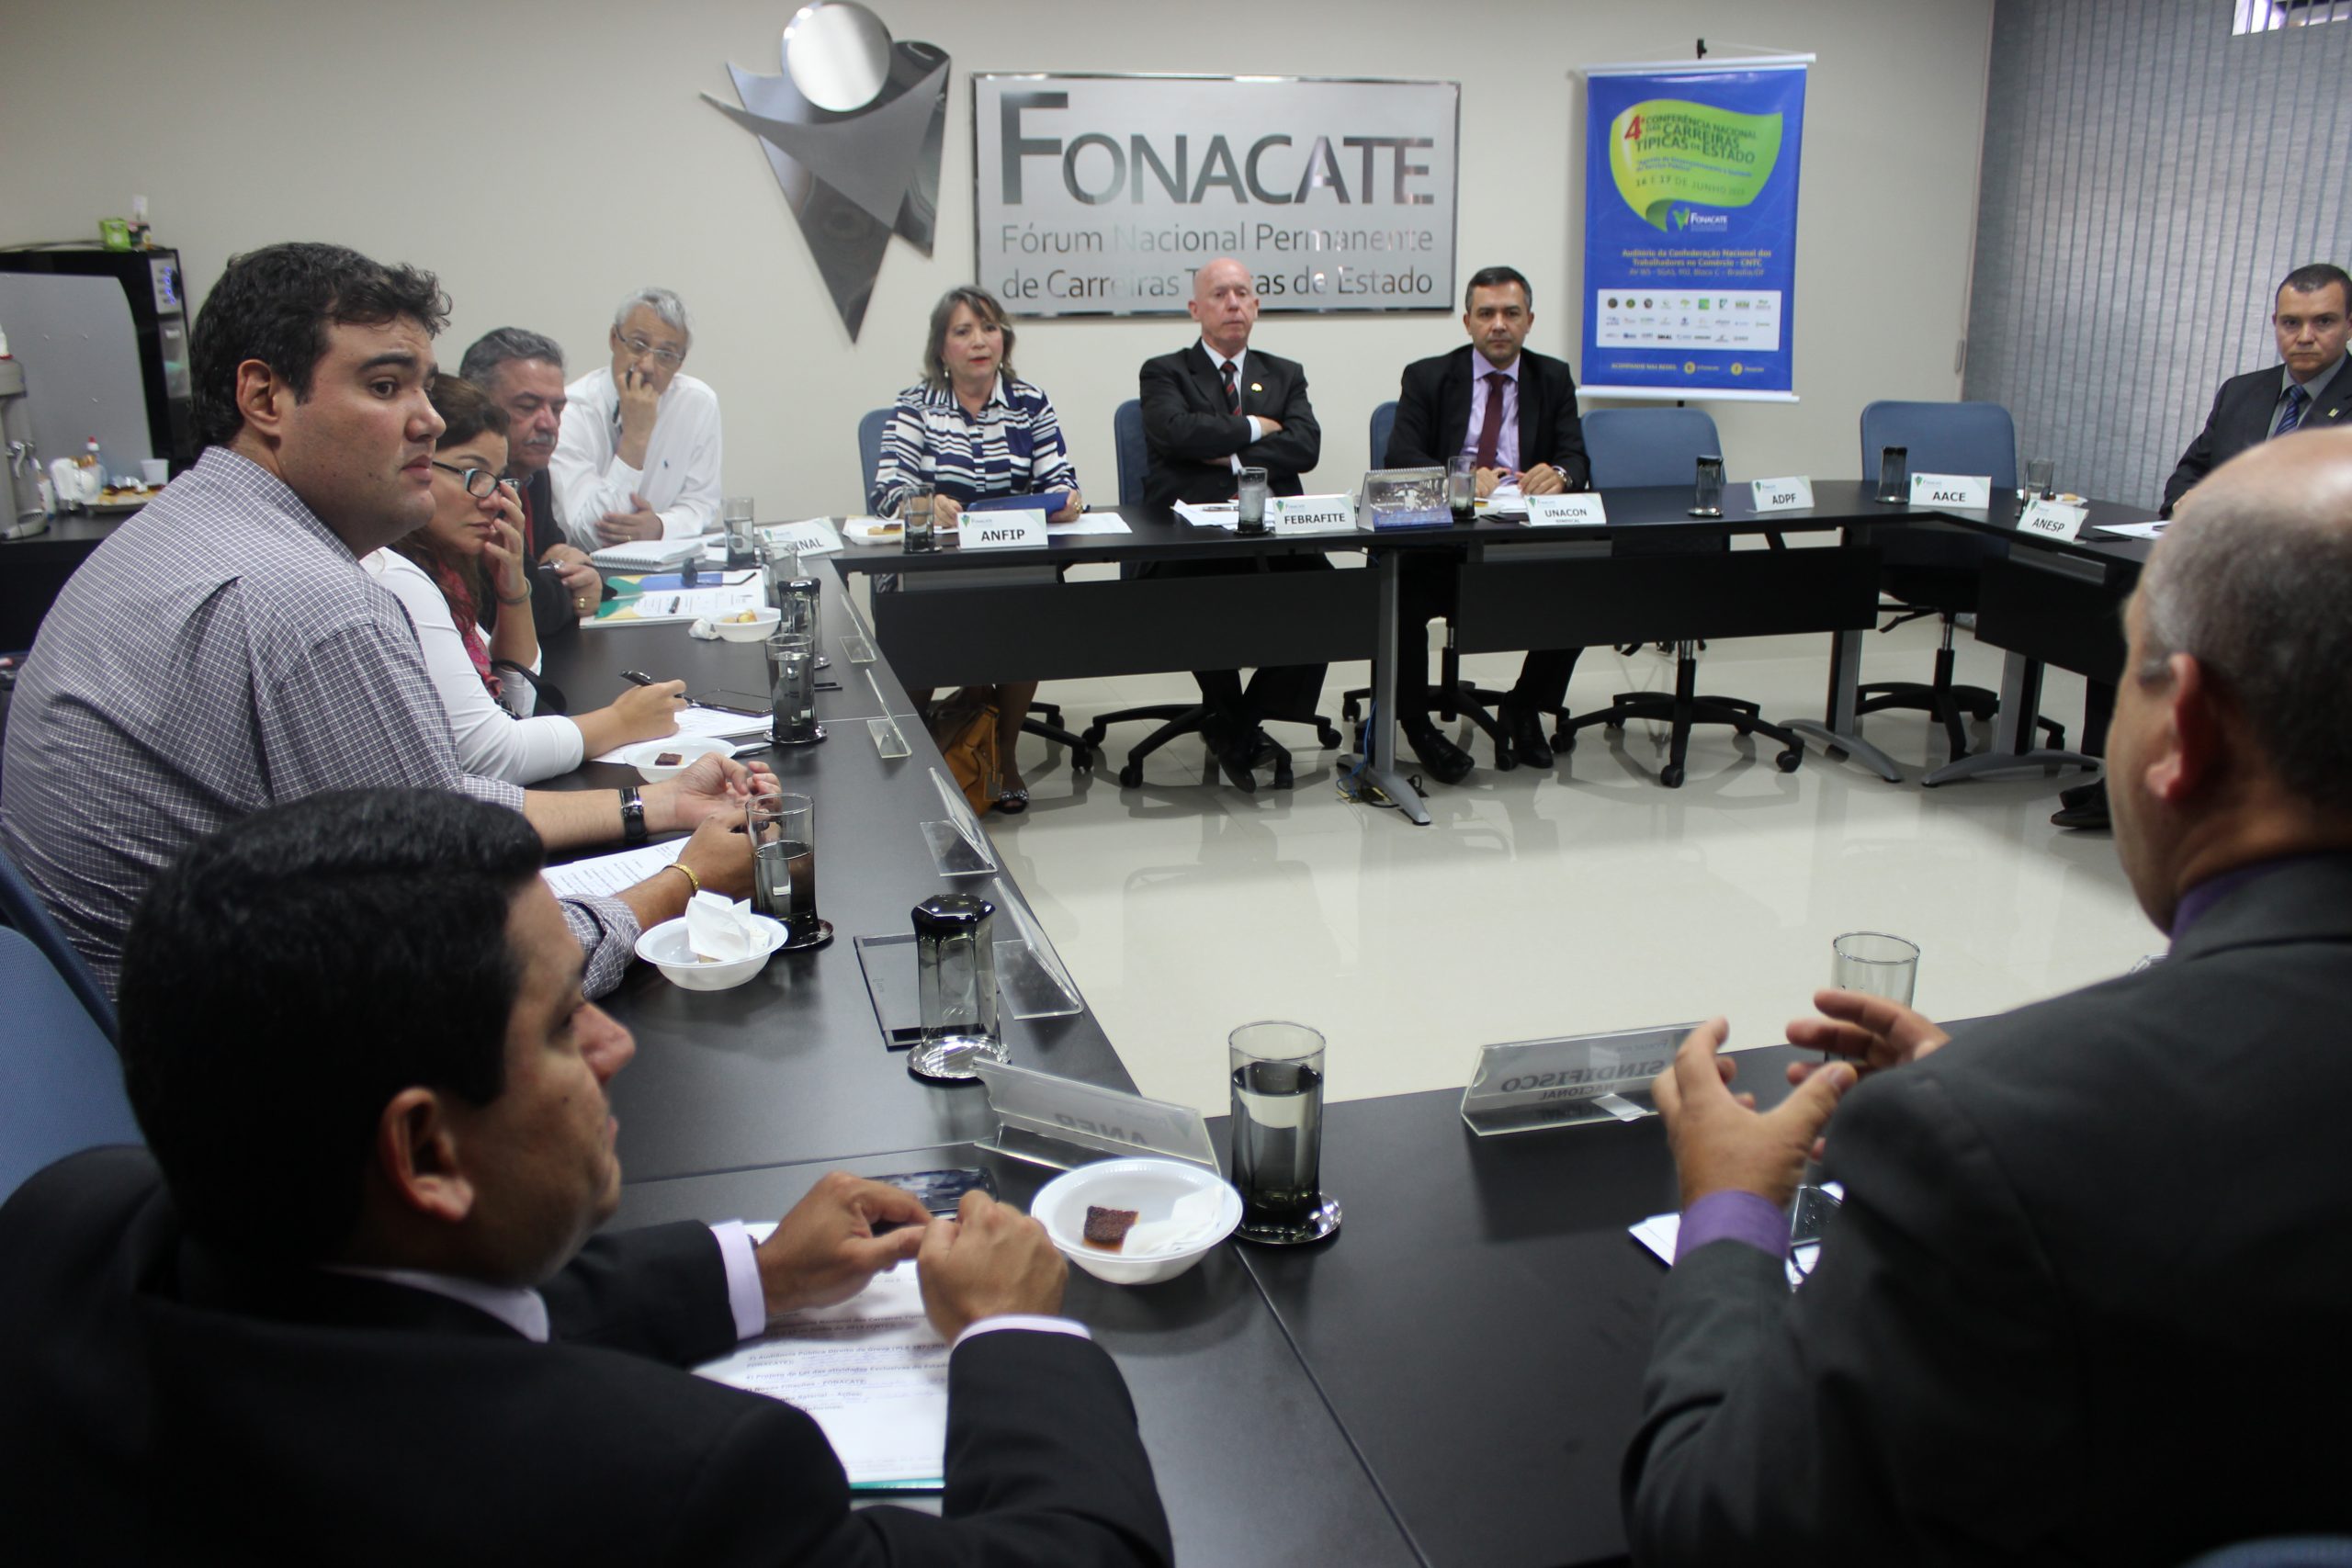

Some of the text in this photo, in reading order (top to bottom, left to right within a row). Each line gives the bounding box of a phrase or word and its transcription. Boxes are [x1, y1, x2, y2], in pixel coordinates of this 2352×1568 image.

[1663, 124, 1739, 149] CARREIRAS
[1712, 123, 1757, 139] NACIONAL
[1001, 92, 1434, 205] FONACATE
[1702, 141, 1756, 164] ESTADO
[1001, 222, 1433, 254] Fórum Nacional Permanente
[1723, 249, 1756, 257] Nacional
[1002, 269, 1039, 299] de
[1046, 269, 1180, 299] Carreiras
[1294, 266, 1327, 295] de
[1337, 265, 1433, 295] Estado
[1772, 493, 1796, 504] ADPF
[1932, 491, 1966, 502] AACE
[1284, 513, 1345, 525] FEBRAFITE
[1544, 508, 1588, 517] UNACON
[2031, 517, 2064, 533] ANESP
[981, 529, 1025, 542] ANFIP
